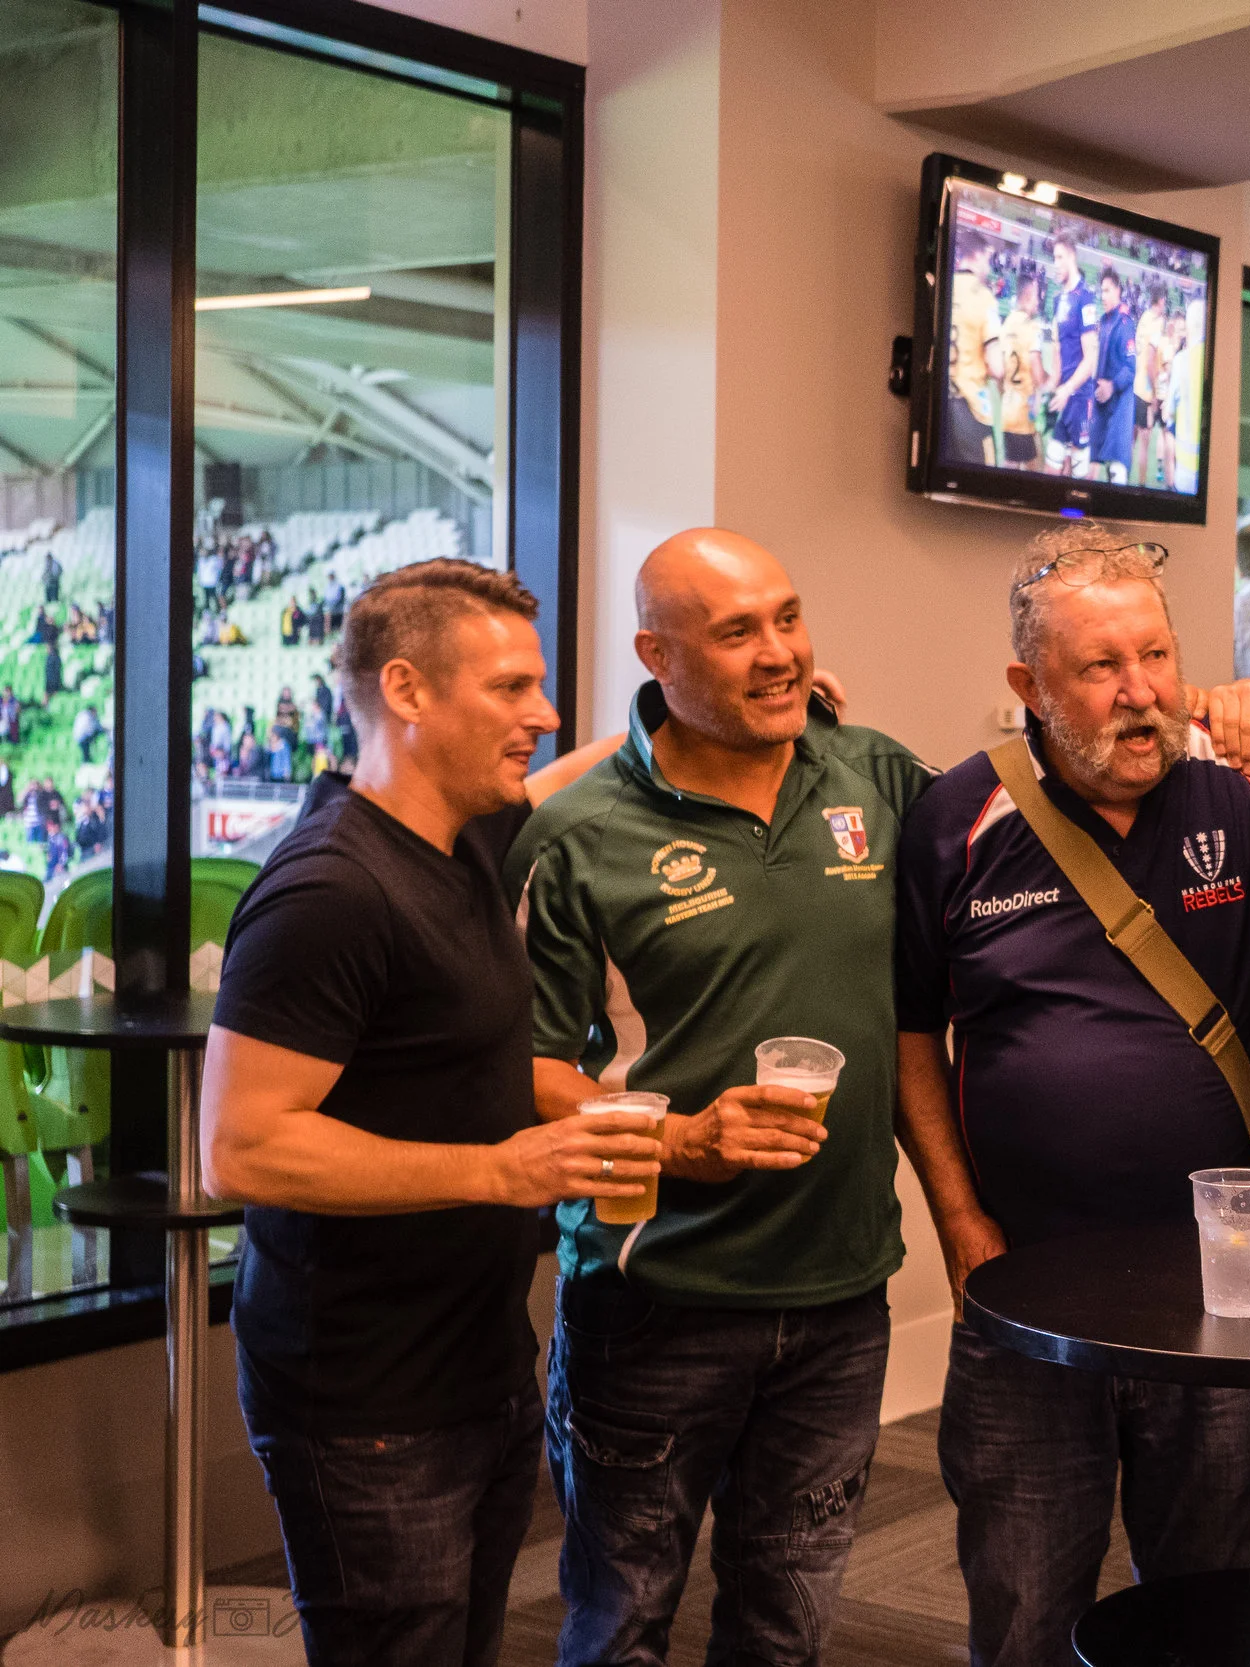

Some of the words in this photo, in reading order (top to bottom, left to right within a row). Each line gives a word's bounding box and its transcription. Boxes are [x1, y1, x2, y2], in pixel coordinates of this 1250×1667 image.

[659, 882, 693, 897] RUGBY
[1181, 875, 1241, 896] MELBOURNE
[1182, 882, 1246, 913] REBELS
[668, 887, 728, 915] MELBOURNE
[970, 887, 1060, 919] RaboDirect
